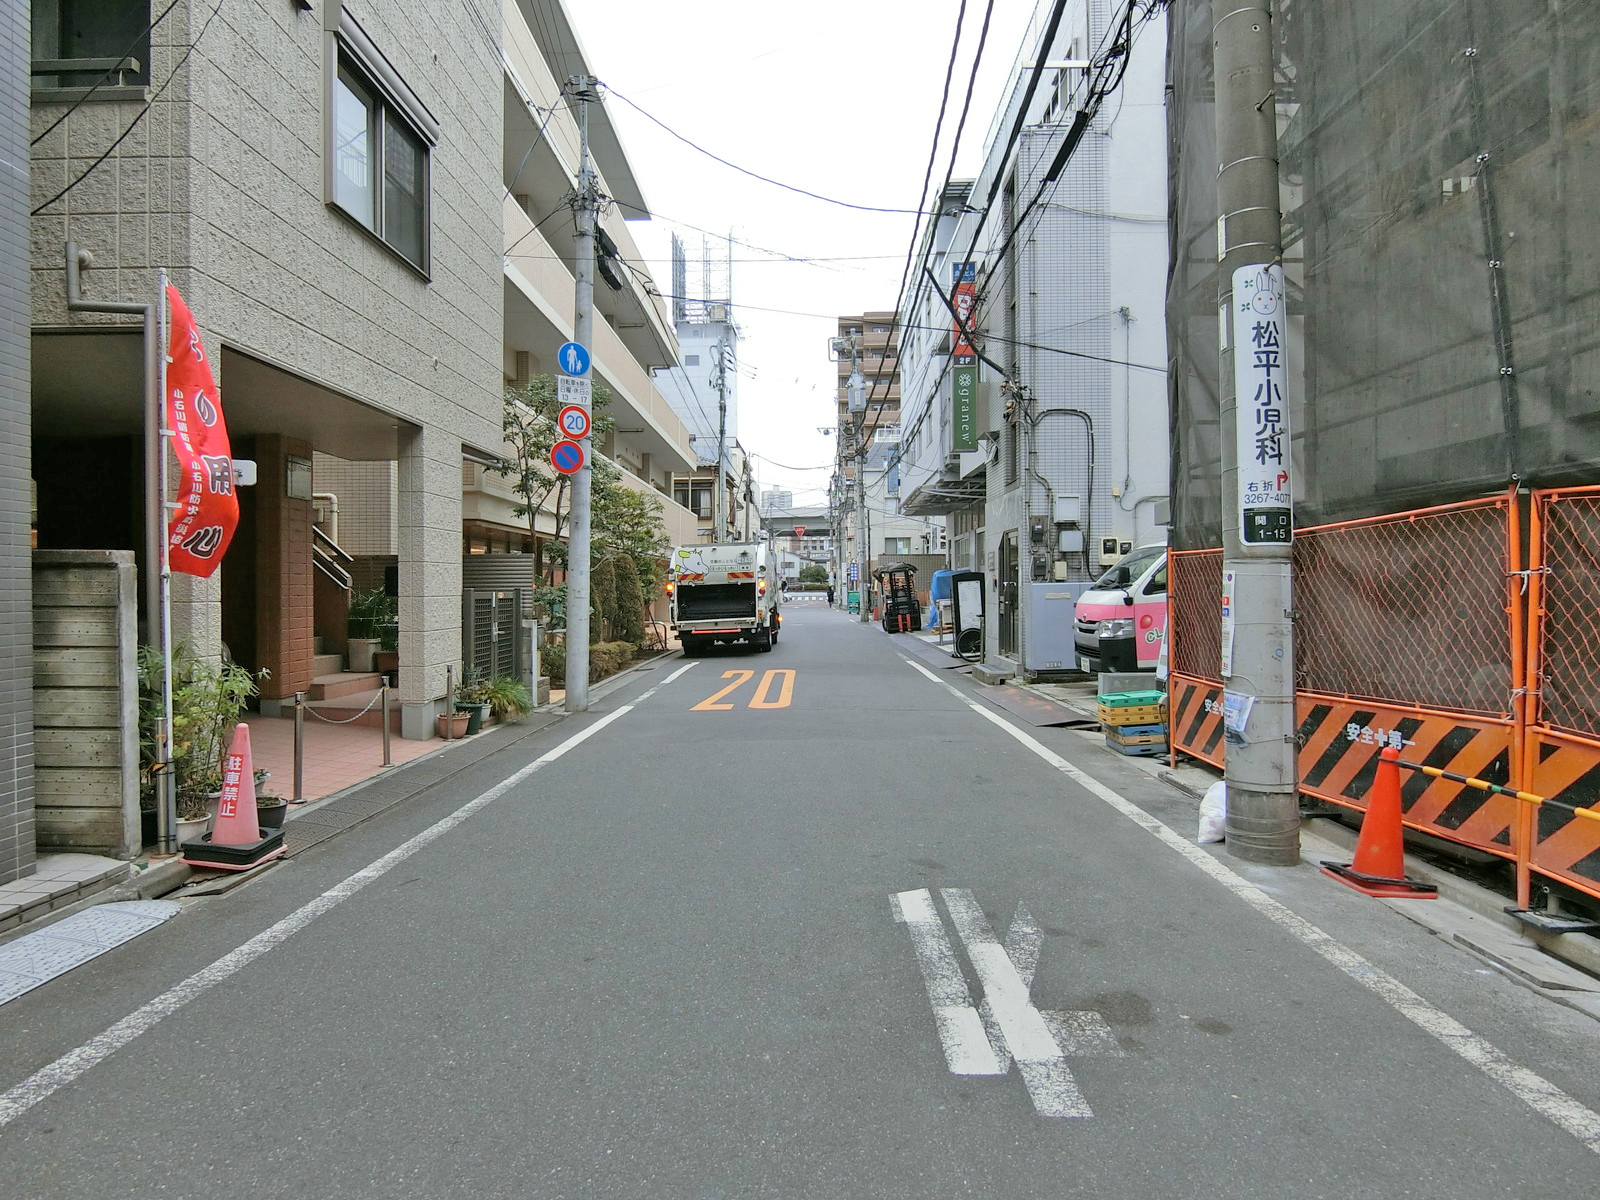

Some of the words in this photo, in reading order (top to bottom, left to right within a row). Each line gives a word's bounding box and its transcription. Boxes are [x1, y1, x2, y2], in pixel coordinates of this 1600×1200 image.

[959, 356, 971, 365] 2F
[1251, 320, 1283, 466] 松平小児科
[566, 415, 584, 430] 20
[958, 389, 971, 444] granew
[1247, 481, 1274, 492] 右折
[1259, 529, 1286, 539] 1-15
[689, 669, 796, 711] 20
[221, 756, 243, 817] 駐車禁止
